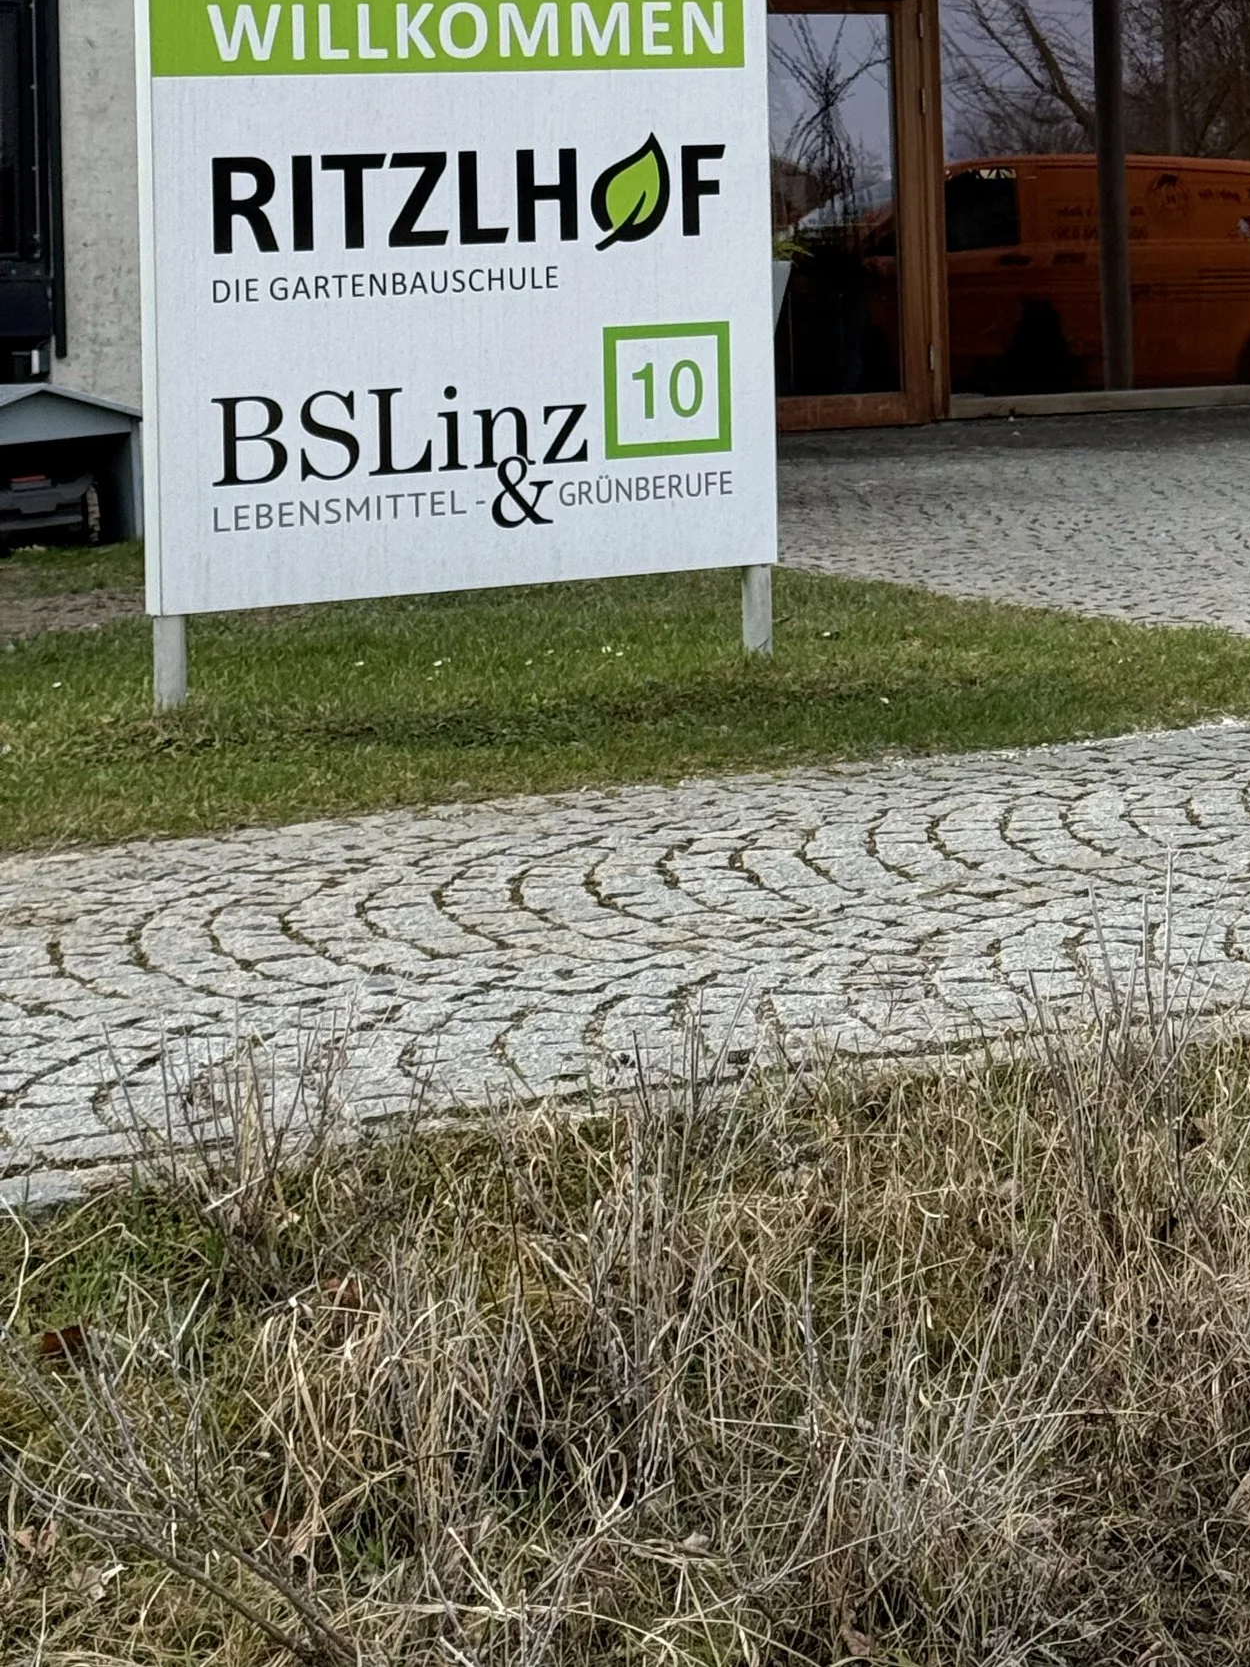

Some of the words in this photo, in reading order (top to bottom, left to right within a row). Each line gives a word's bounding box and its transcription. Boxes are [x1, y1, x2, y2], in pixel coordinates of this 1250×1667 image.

[206, 1, 725, 62] WILLKOMMEN
[212, 278, 259, 304] DIE
[269, 266, 559, 301] GARTENBAUSCHULE
[211, 385, 588, 487] BSLinz
[632, 359, 704, 419] 10
[491, 456, 554, 529] &
[559, 470, 733, 507] GRÜNBERUFE
